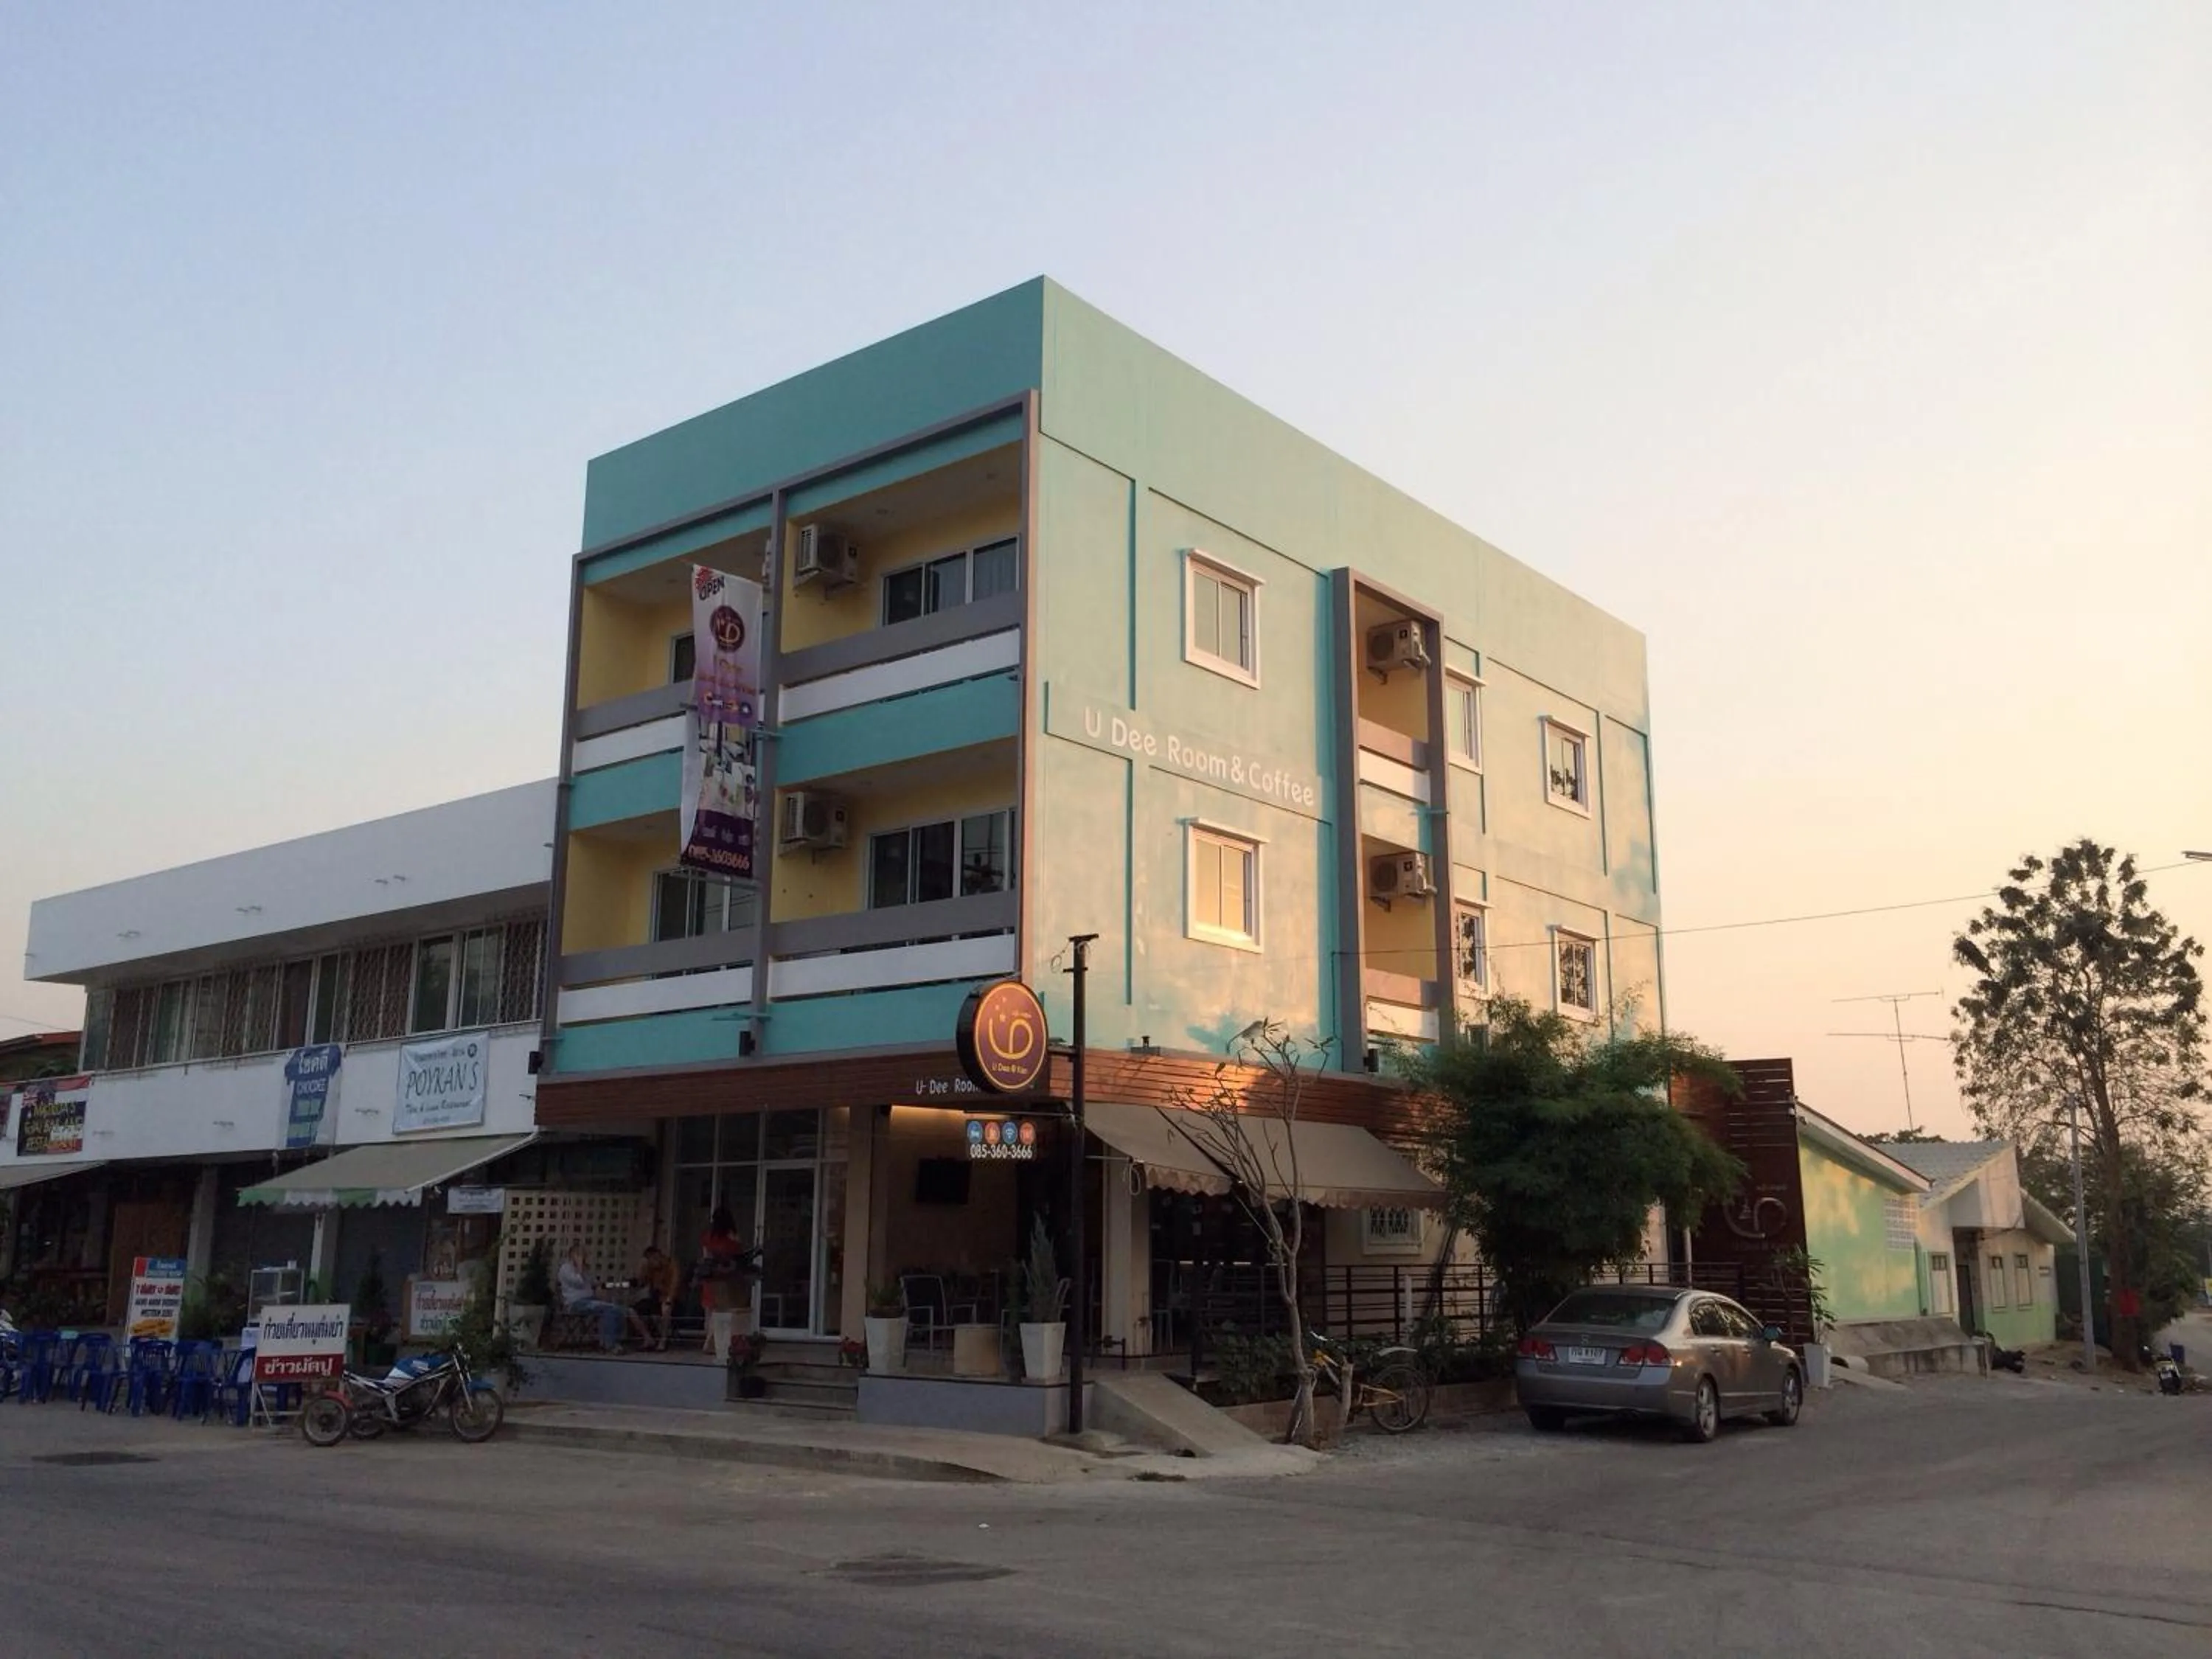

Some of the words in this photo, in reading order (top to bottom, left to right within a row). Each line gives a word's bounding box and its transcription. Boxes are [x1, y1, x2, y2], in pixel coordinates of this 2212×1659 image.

[699, 575, 725, 601] OPEN
[1085, 706, 1102, 738] U
[1111, 717, 1158, 757] Dee
[970, 1144, 1033, 1160] 085-360-3666
[265, 1357, 333, 1377] ข้าวผัดปู
